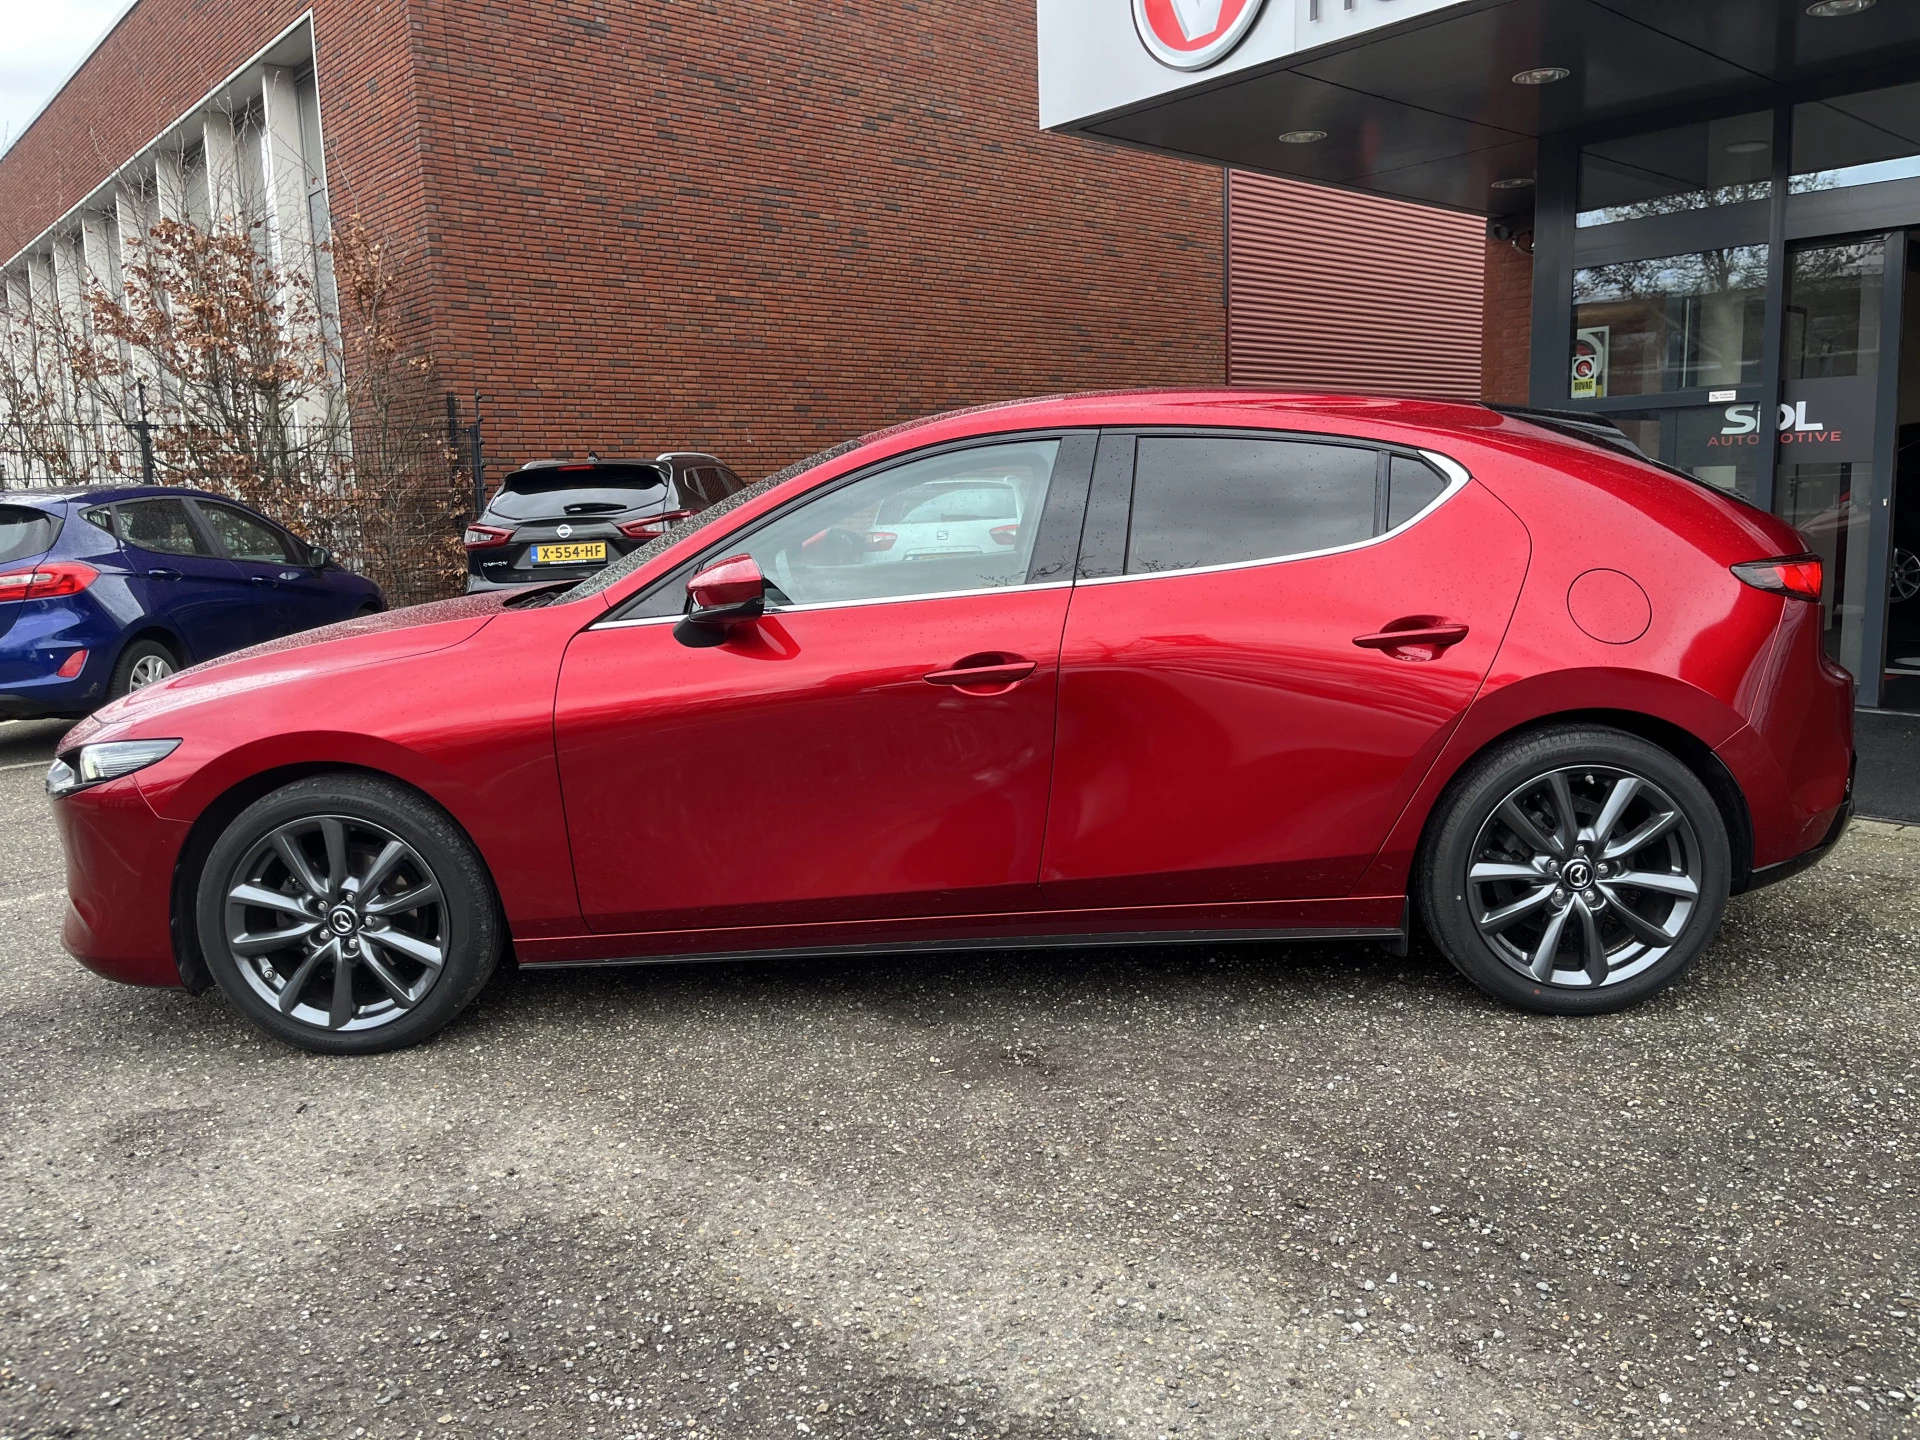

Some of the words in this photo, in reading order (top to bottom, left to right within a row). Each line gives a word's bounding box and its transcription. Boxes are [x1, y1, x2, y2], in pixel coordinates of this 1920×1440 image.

[1574, 381, 1593, 391] BOVAG
[1707, 431, 1842, 446] AUTOOTIVE
[542, 545, 602, 560] X-554-HF
